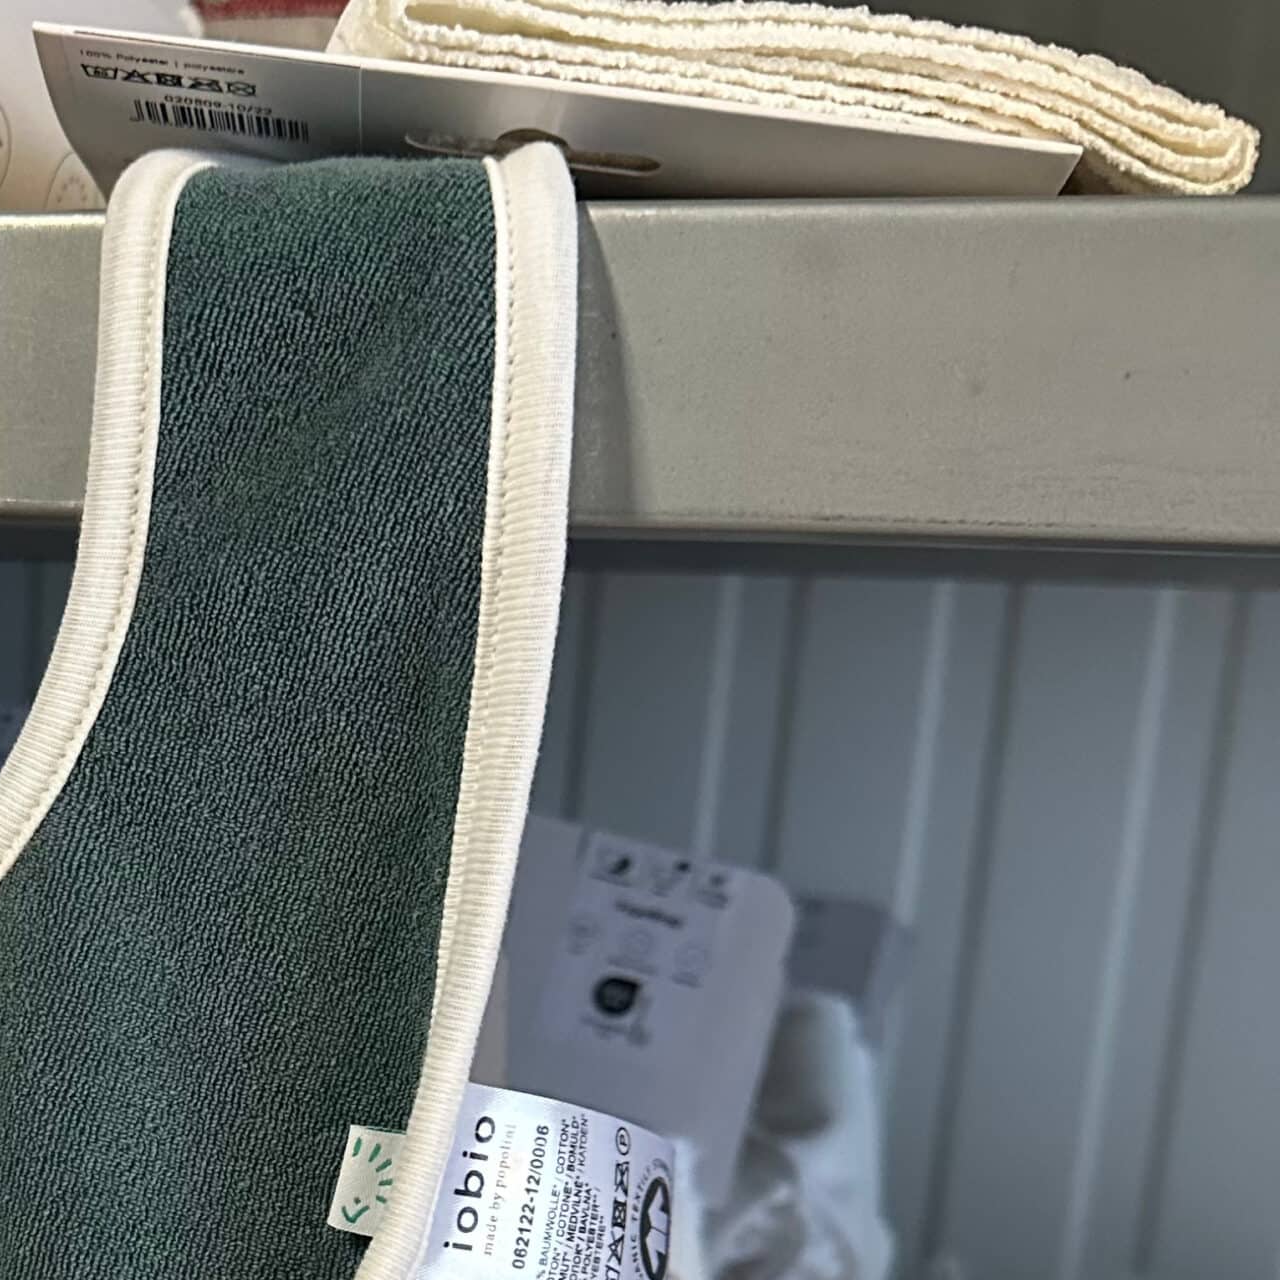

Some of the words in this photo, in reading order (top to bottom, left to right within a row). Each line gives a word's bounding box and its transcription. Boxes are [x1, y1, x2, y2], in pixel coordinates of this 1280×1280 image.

[443, 1115, 496, 1252] iobio
[489, 1191, 506, 1211] by
[483, 1215, 499, 1257] made
